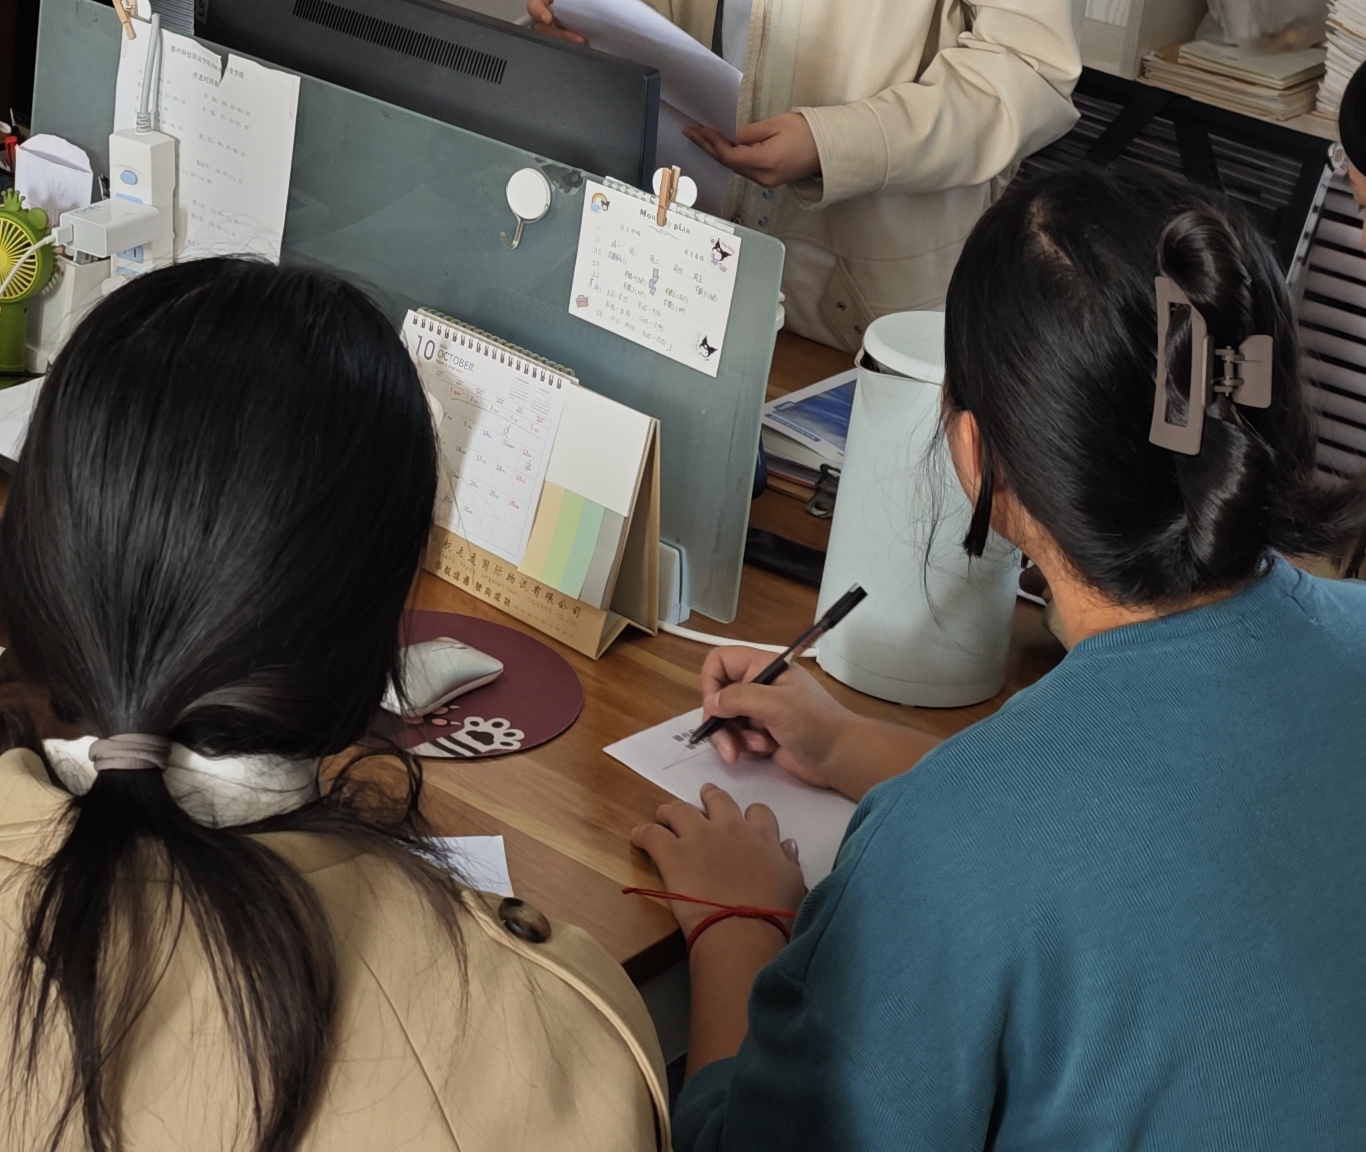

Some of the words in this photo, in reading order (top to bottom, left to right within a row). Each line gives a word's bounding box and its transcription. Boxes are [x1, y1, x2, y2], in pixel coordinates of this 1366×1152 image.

[674, 223, 691, 235] plan
[416, 335, 435, 360] 10
[438, 349, 474, 372] OCTOBER
